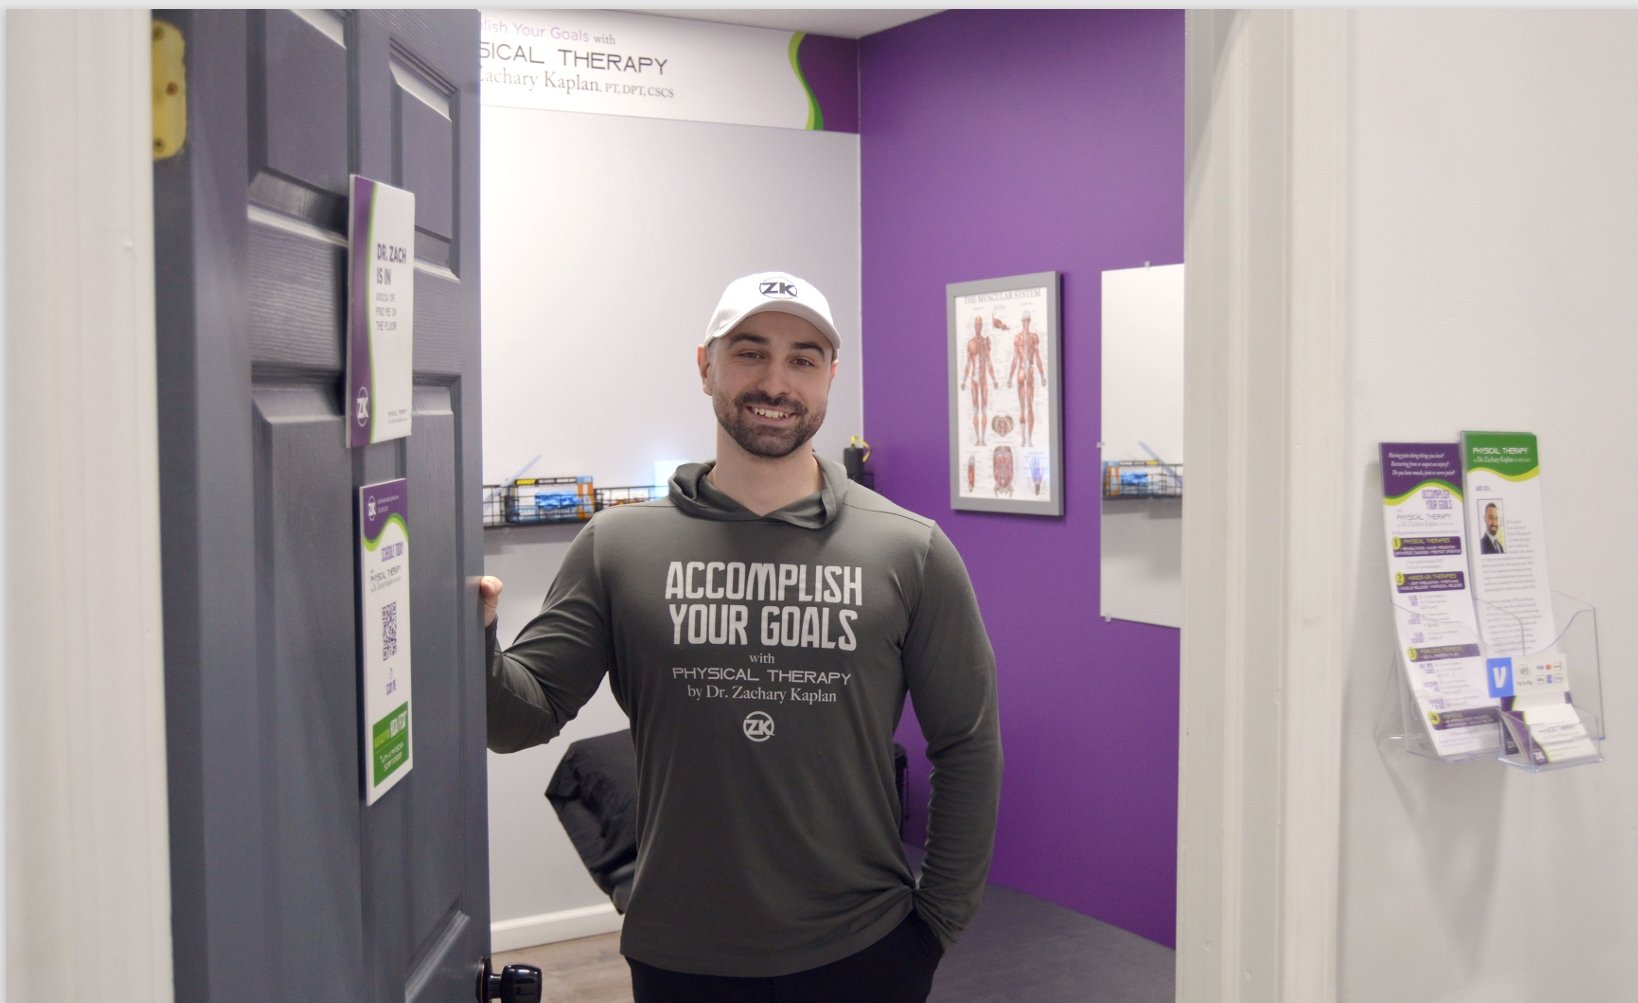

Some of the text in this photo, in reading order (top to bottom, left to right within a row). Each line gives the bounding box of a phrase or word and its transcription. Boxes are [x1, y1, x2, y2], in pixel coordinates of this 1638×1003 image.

[512, 22, 545, 37] Your
[550, 26, 589, 42] Goals
[593, 33, 616, 45] with
[557, 49, 668, 75] THERAPY
[480, 65, 538, 91] achary
[377, 243, 406, 264] DR. ZACH
[376, 266, 391, 286] IS IN
[760, 281, 798, 298] ZK
[357, 397, 369, 419] ZK
[1502, 447, 1529, 455] THERAPY
[665, 561, 863, 606] ACCOMPLISH
[668, 604, 858, 652] YOUR GOALS
[749, 652, 775, 664] with
[672, 667, 852, 686] PHYSICAL THERAPY
[687, 685, 837, 705] by Dr. Zachary Kaplan
[743, 719, 775, 736] ZK
